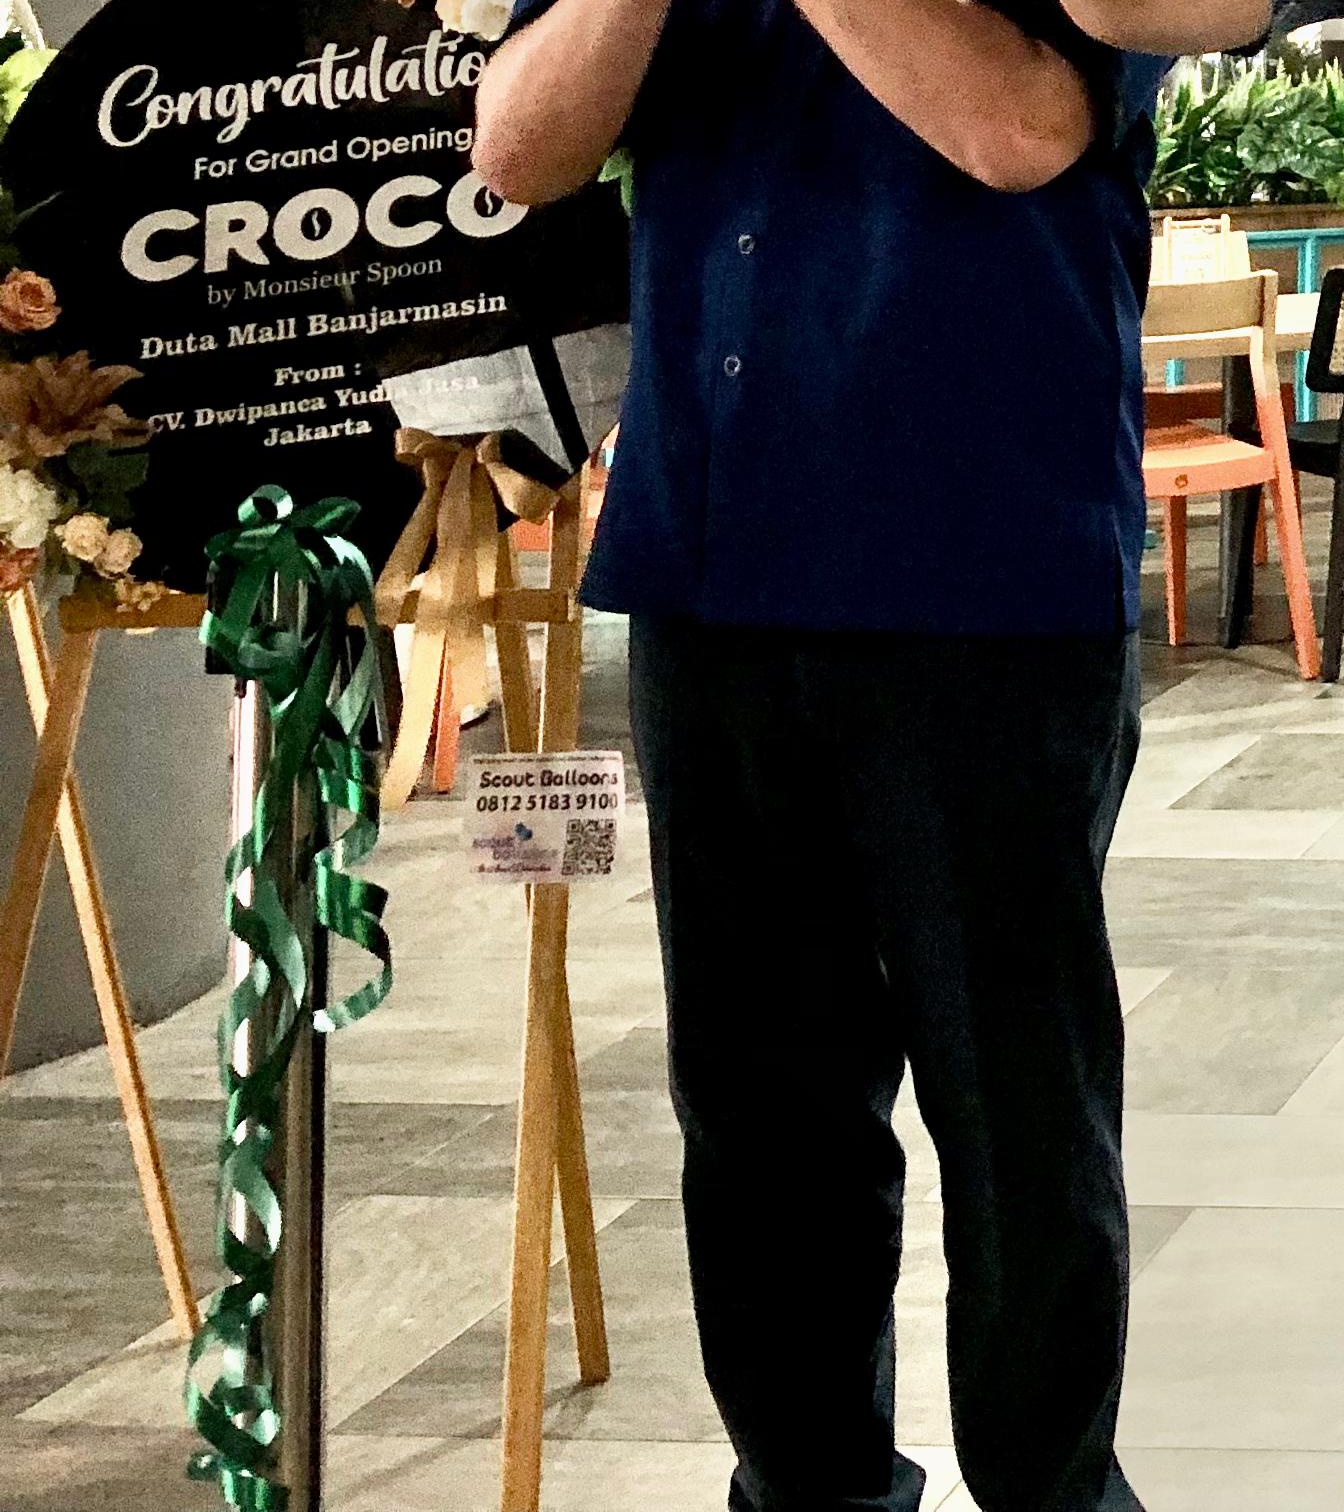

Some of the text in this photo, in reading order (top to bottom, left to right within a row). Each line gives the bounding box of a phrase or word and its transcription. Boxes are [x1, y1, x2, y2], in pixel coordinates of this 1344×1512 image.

[97, 29, 488, 148] Congratulatio
[193, 126, 474, 181] For Grand Opening
[121, 172, 530, 283] CROCO
[207, 257, 443, 309] by Monsieur Spoon
[139, 292, 508, 360] Duta Mall Banjarmasin
[273, 361, 346, 387] From
[263, 416, 373, 448] Jakarta
[476, 793, 618, 813] 0812 5183 9100
[479, 771, 535, 789] Scout
